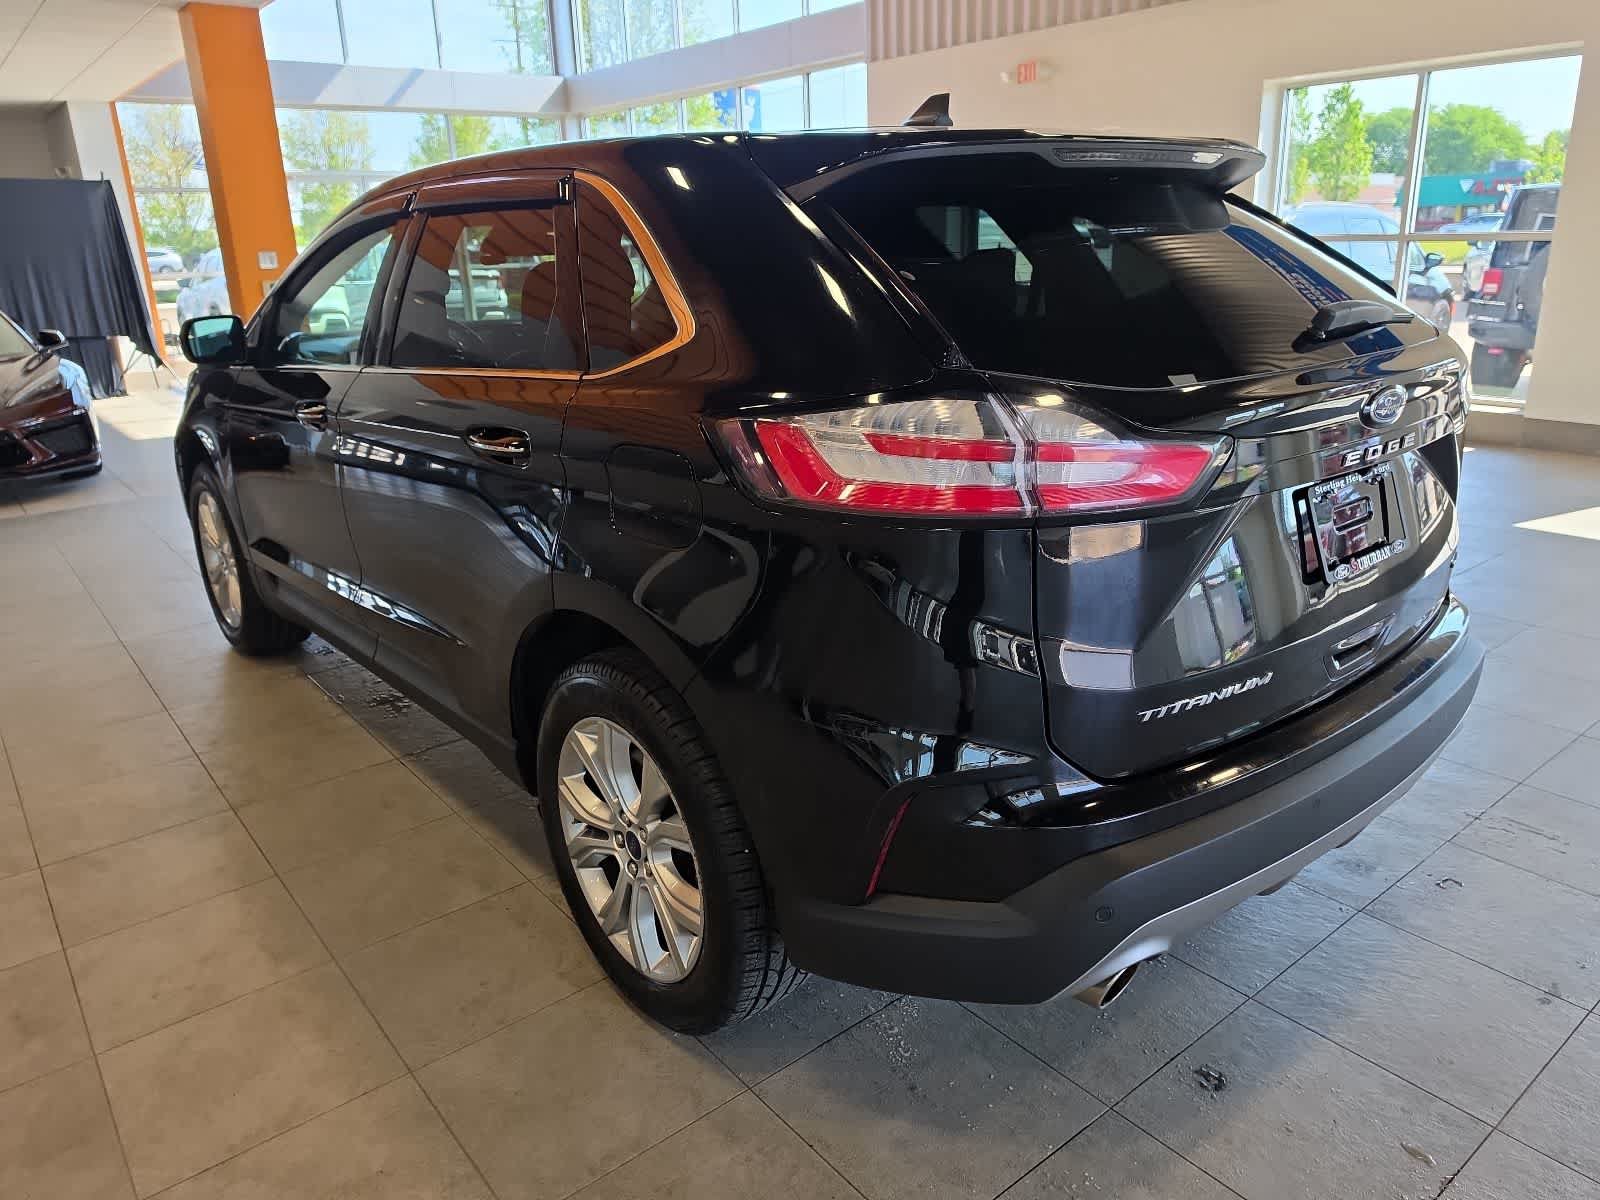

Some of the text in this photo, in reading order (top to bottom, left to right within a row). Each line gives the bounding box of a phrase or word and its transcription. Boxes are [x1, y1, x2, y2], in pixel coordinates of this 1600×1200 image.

[1341, 432, 1416, 467] EDGE
[1314, 480, 1345, 495] Sterling
[1350, 546, 1391, 574] SUBURBAN
[1137, 671, 1274, 722] TITANIUM
